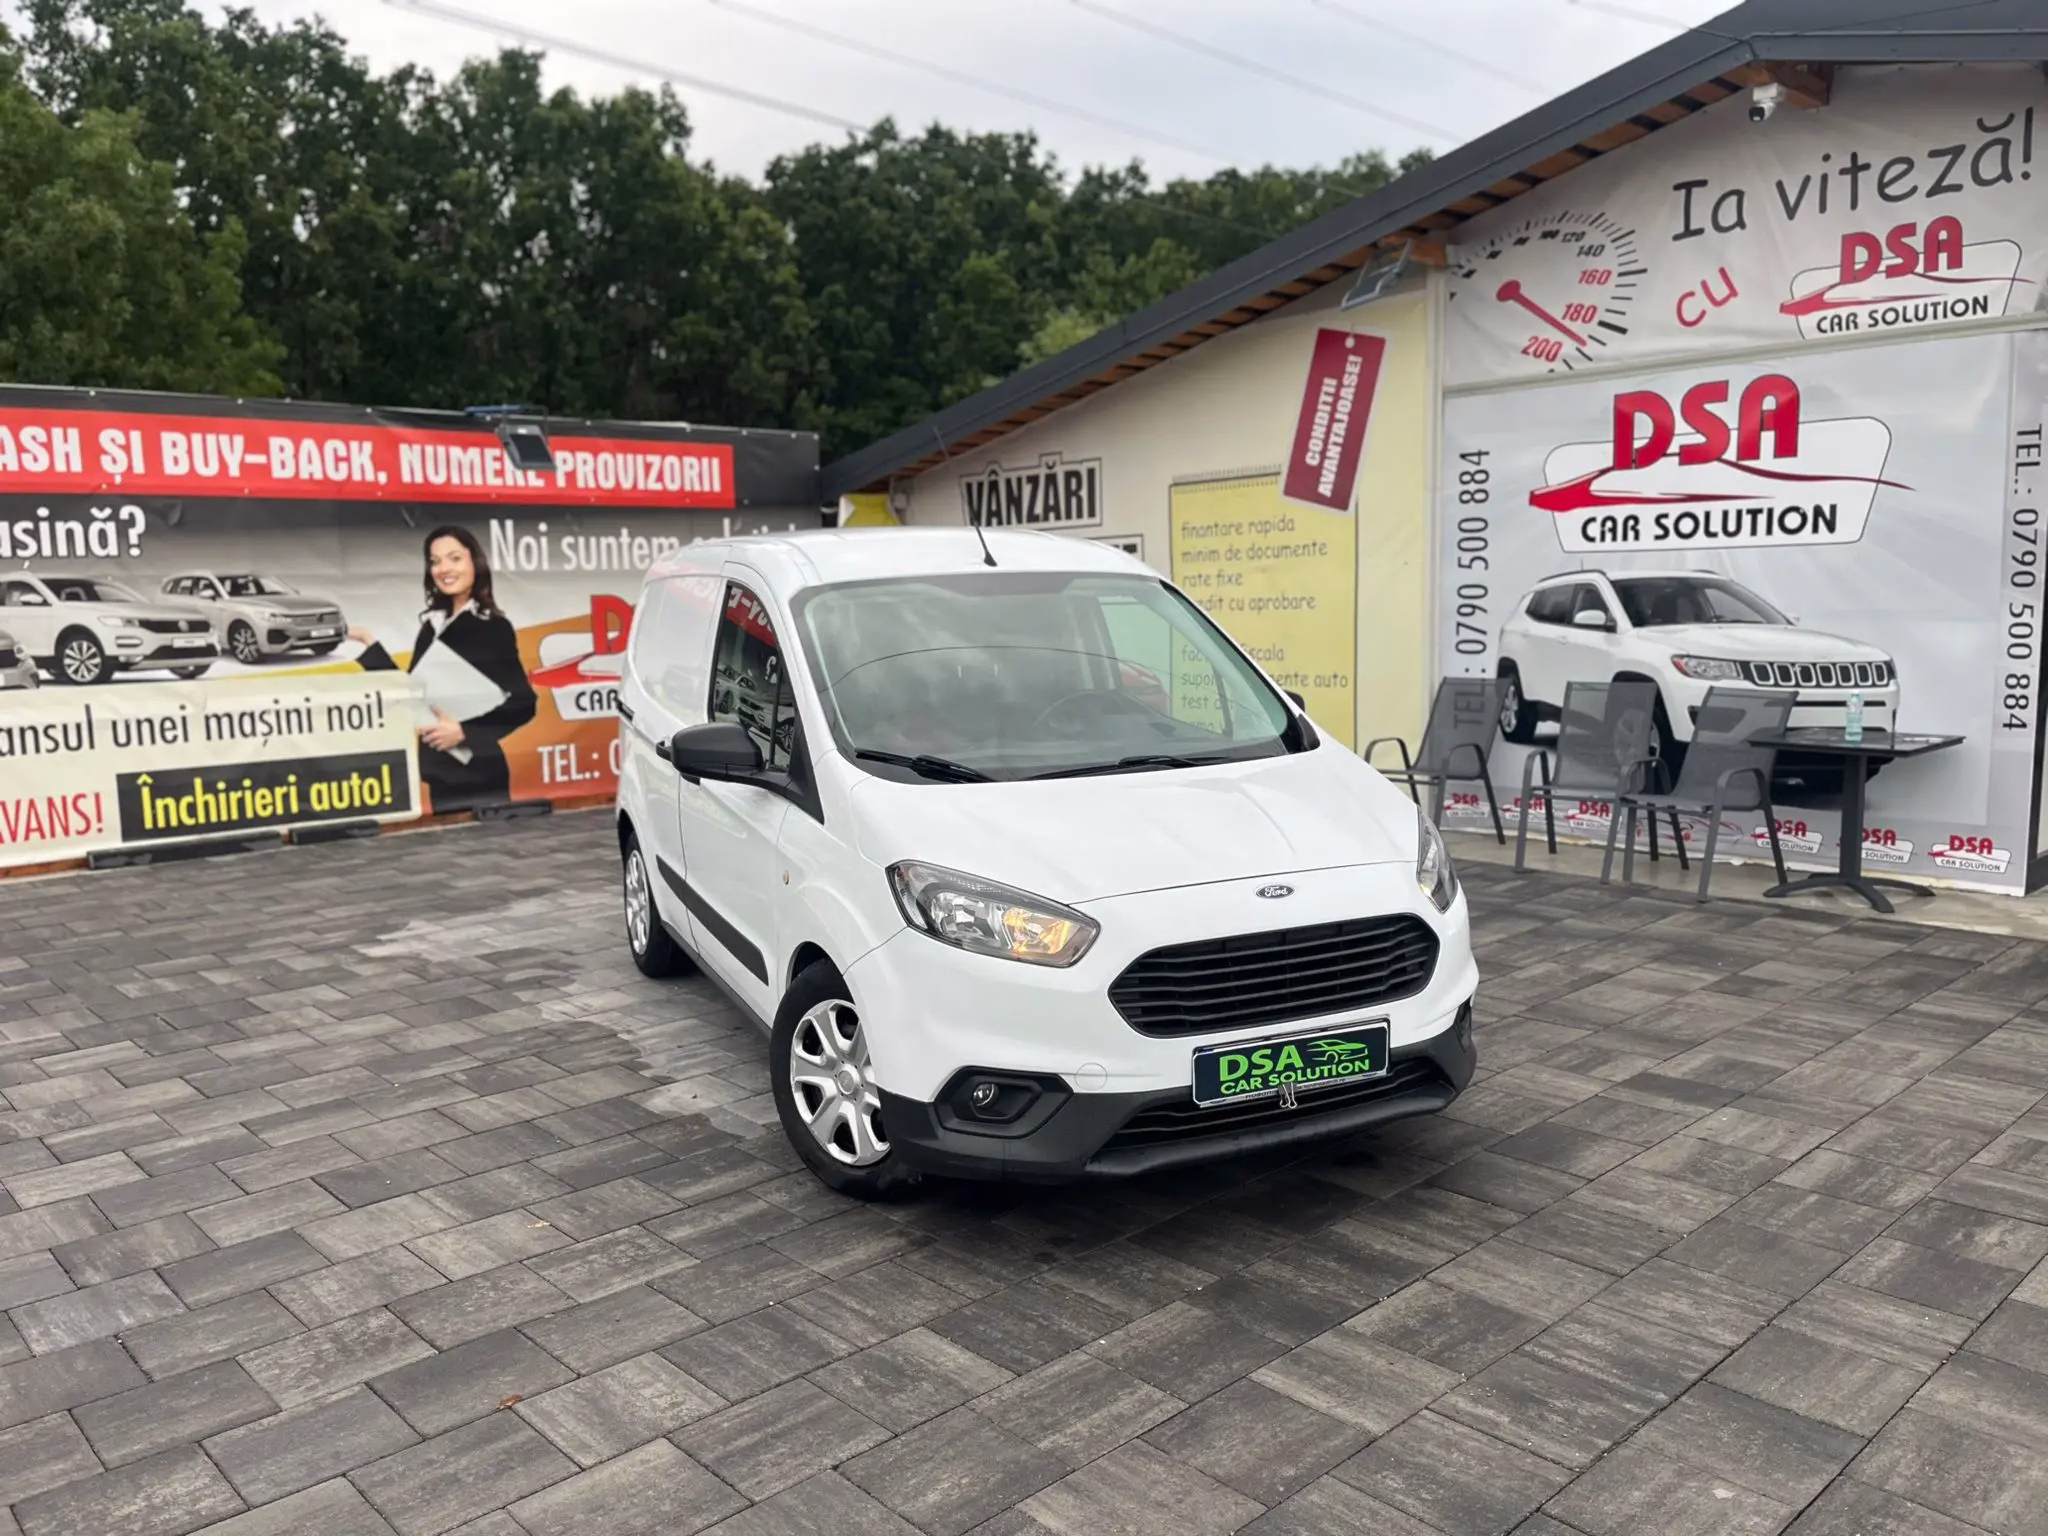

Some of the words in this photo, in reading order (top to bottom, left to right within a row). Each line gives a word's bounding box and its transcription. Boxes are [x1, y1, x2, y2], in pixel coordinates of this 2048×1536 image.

[1671, 178, 1747, 242] Ia
[1775, 106, 2035, 222] viteză!
[1561, 231, 1587, 243] 120
[1576, 244, 1605, 257] 140
[1839, 214, 1964, 285] DSA
[1578, 269, 1612, 285] 160
[1675, 266, 1740, 328] cu
[1561, 303, 1598, 324] 180
[1816, 311, 1859, 334] CAR
[1867, 295, 1990, 329] SOLUTION
[1520, 335, 1564, 362] 200
[1317, 354, 1364, 499] AVANTAJOASE!
[1612, 373, 1801, 470] DSA
[100, 428, 145, 485] ȘI
[160, 431, 389, 485] BUY-BACK,
[554, 449, 721, 493] PROVIZORII
[1458, 448, 1491, 504] 884
[2014, 423, 2043, 496] TEL.:
[964, 460, 1097, 528] VÂNZĂRI
[1180, 521, 1244, 540] finantare
[1248, 514, 1295, 538] rapida
[1580, 514, 1641, 544] CAR
[1653, 503, 1838, 541] SOLUTION
[488, 518, 550, 571] Noi
[561, 526, 680, 571] suntem
[1181, 547, 1221, 564] minim
[1225, 545, 1242, 561] de
[1246, 540, 1328, 560] documente
[1457, 518, 1490, 571] 500
[2010, 507, 2040, 589] 0790
[1182, 573, 1211, 588] rate
[1216, 569, 1244, 587] fixe
[1228, 598, 1245, 612] cu
[1248, 590, 1317, 615] aprobare
[1455, 583, 1489, 656] 0790
[2006, 602, 2035, 660] 500
[1314, 673, 1349, 688] auto
[111, 704, 190, 748] unei
[203, 698, 314, 748] mașini
[326, 691, 386, 732] noi!
[1181, 694, 1210, 709] test
[2001, 673, 2031, 732] 884
[537, 742, 600, 784] TEL.:
[135, 773, 300, 831] Închirieri
[310, 763, 393, 812] auto!
[1578, 799, 1612, 817] DSA
[0, 792, 104, 845] VANS!
[1949, 834, 1994, 855] DSA
[1958, 860, 2001, 872] SOLUTION
[1264, 884, 1289, 897] Ford
[1219, 1044, 1305, 1082] DSA
[1220, 1077, 1263, 1096] CAR
[1268, 1058, 1371, 1086] SOLUTION
